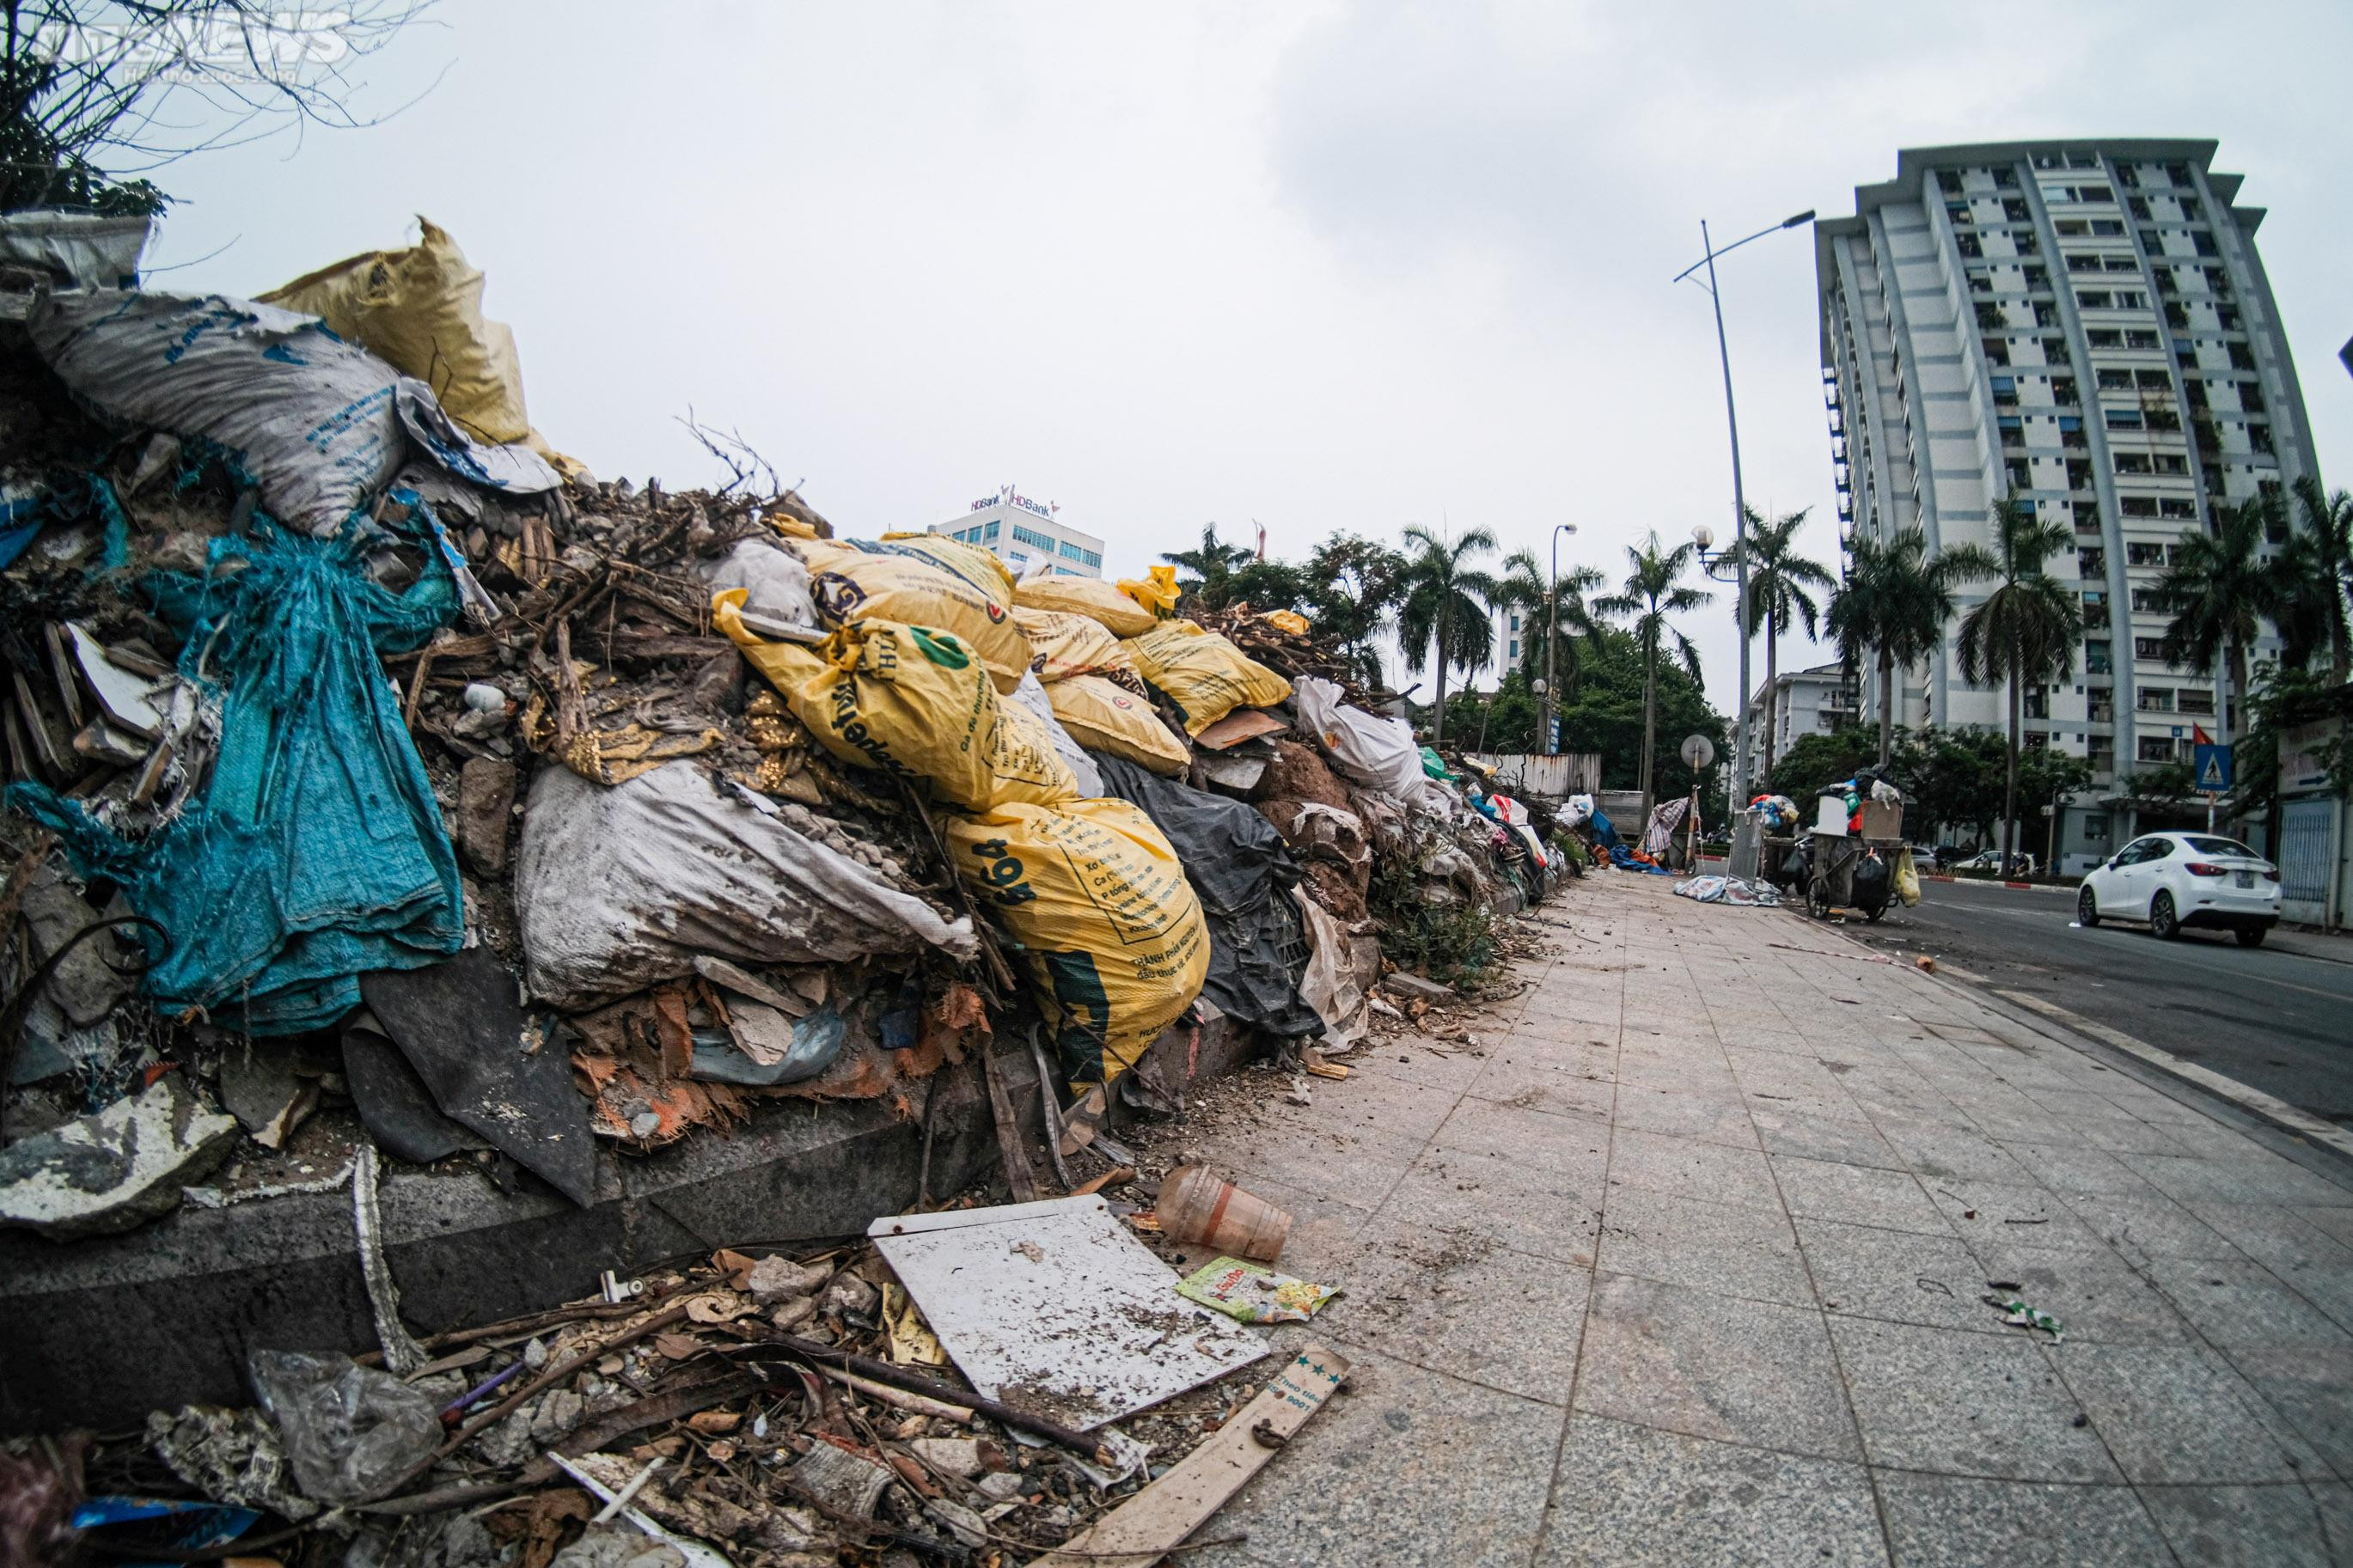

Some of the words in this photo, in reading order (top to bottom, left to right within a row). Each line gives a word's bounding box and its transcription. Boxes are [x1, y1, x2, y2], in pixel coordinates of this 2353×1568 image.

[971, 494, 1000, 511] HDBank
[1011, 493, 1049, 517] HDBank
[1094, 876, 1106, 887] Ca
[1267, 1383, 1285, 1397] IS
